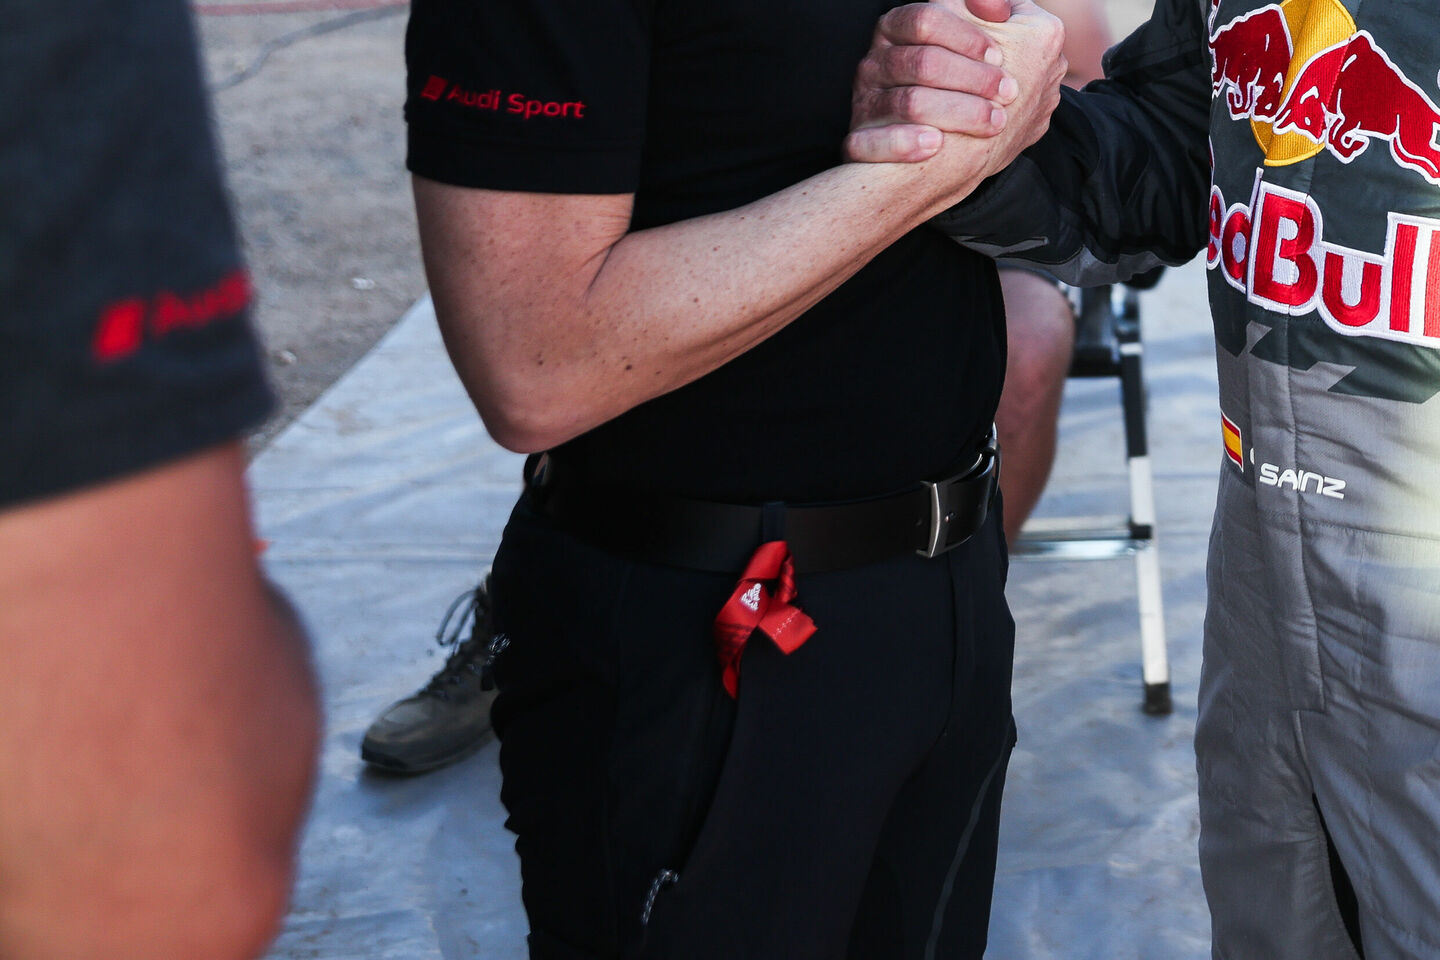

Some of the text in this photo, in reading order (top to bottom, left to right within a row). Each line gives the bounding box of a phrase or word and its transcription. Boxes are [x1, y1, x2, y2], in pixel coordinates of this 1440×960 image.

[447, 83, 587, 120] Audi Sport
[1259, 462, 1346, 500] SAINZ
